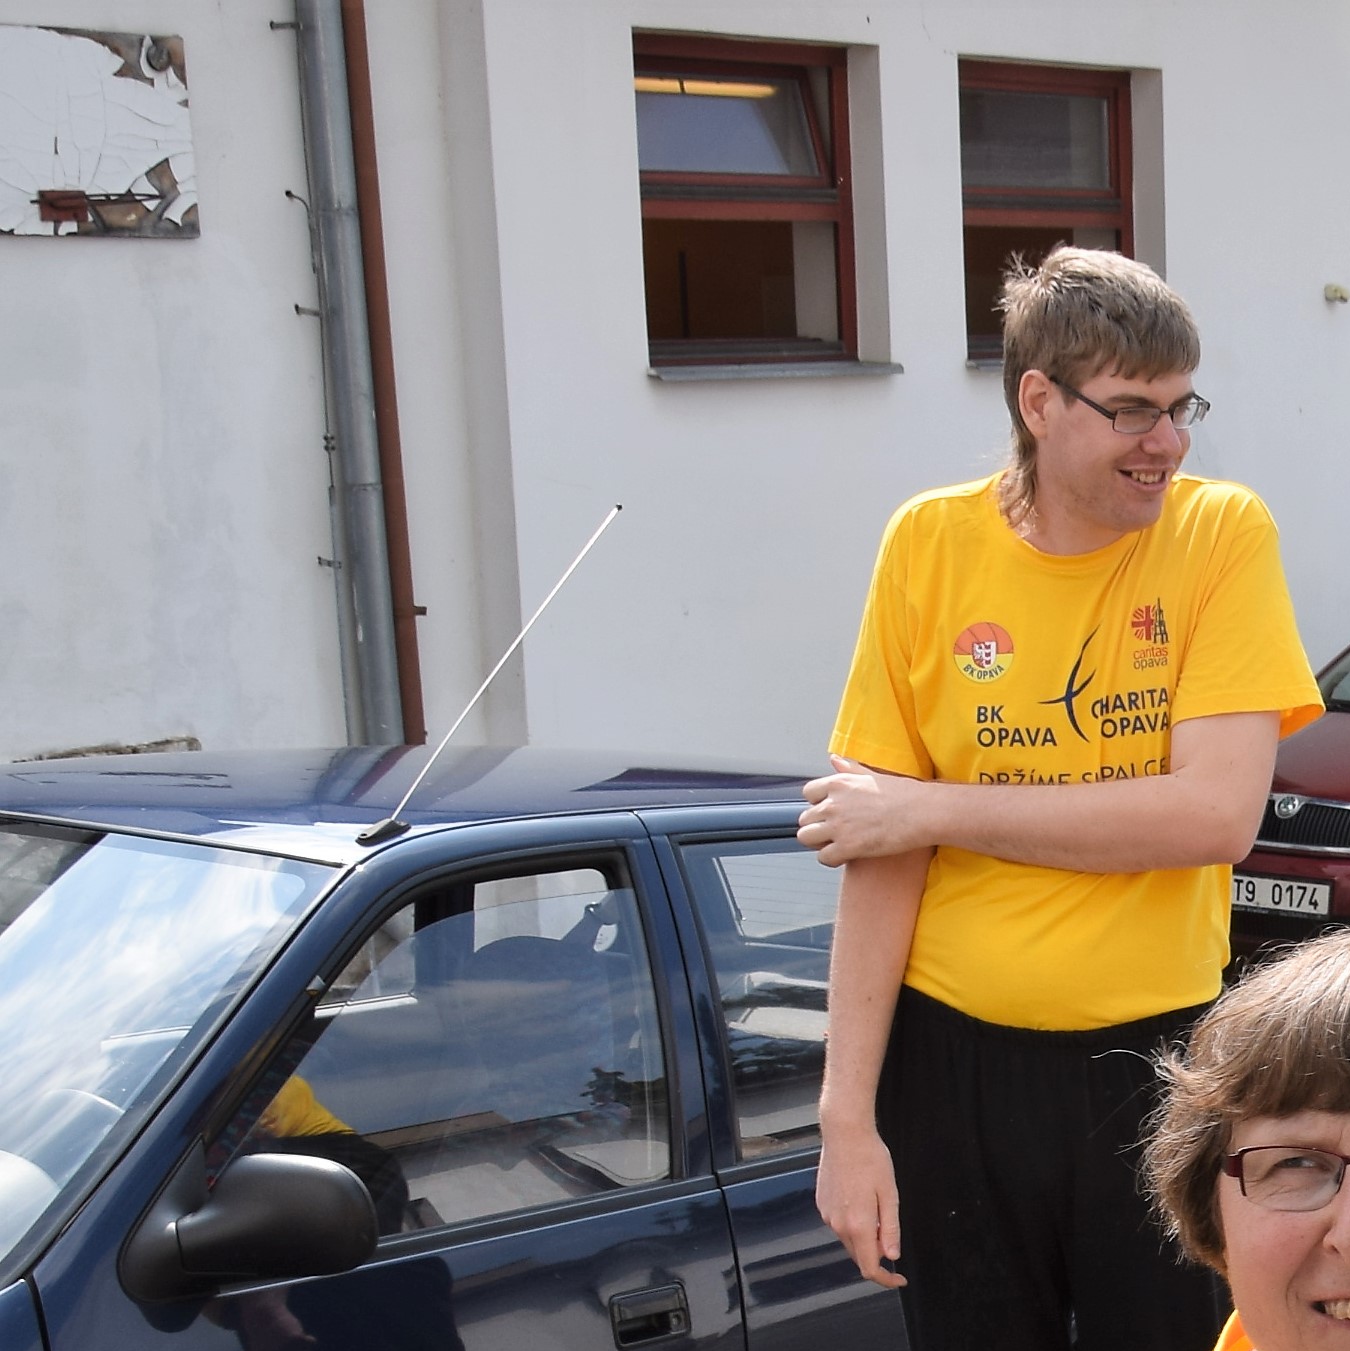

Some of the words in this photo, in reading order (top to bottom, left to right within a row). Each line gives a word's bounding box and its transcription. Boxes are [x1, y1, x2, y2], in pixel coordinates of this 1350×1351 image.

[1133, 645, 1168, 660] caritas
[963, 664, 976, 677] BK
[976, 664, 1005, 680] OPAVA
[1133, 655, 1168, 671] opava
[976, 705, 1005, 724] BK
[1100, 711, 1169, 739] OPAVA
[976, 727, 1057, 748] OPAVA
[1272, 883, 1319, 910] 0174
